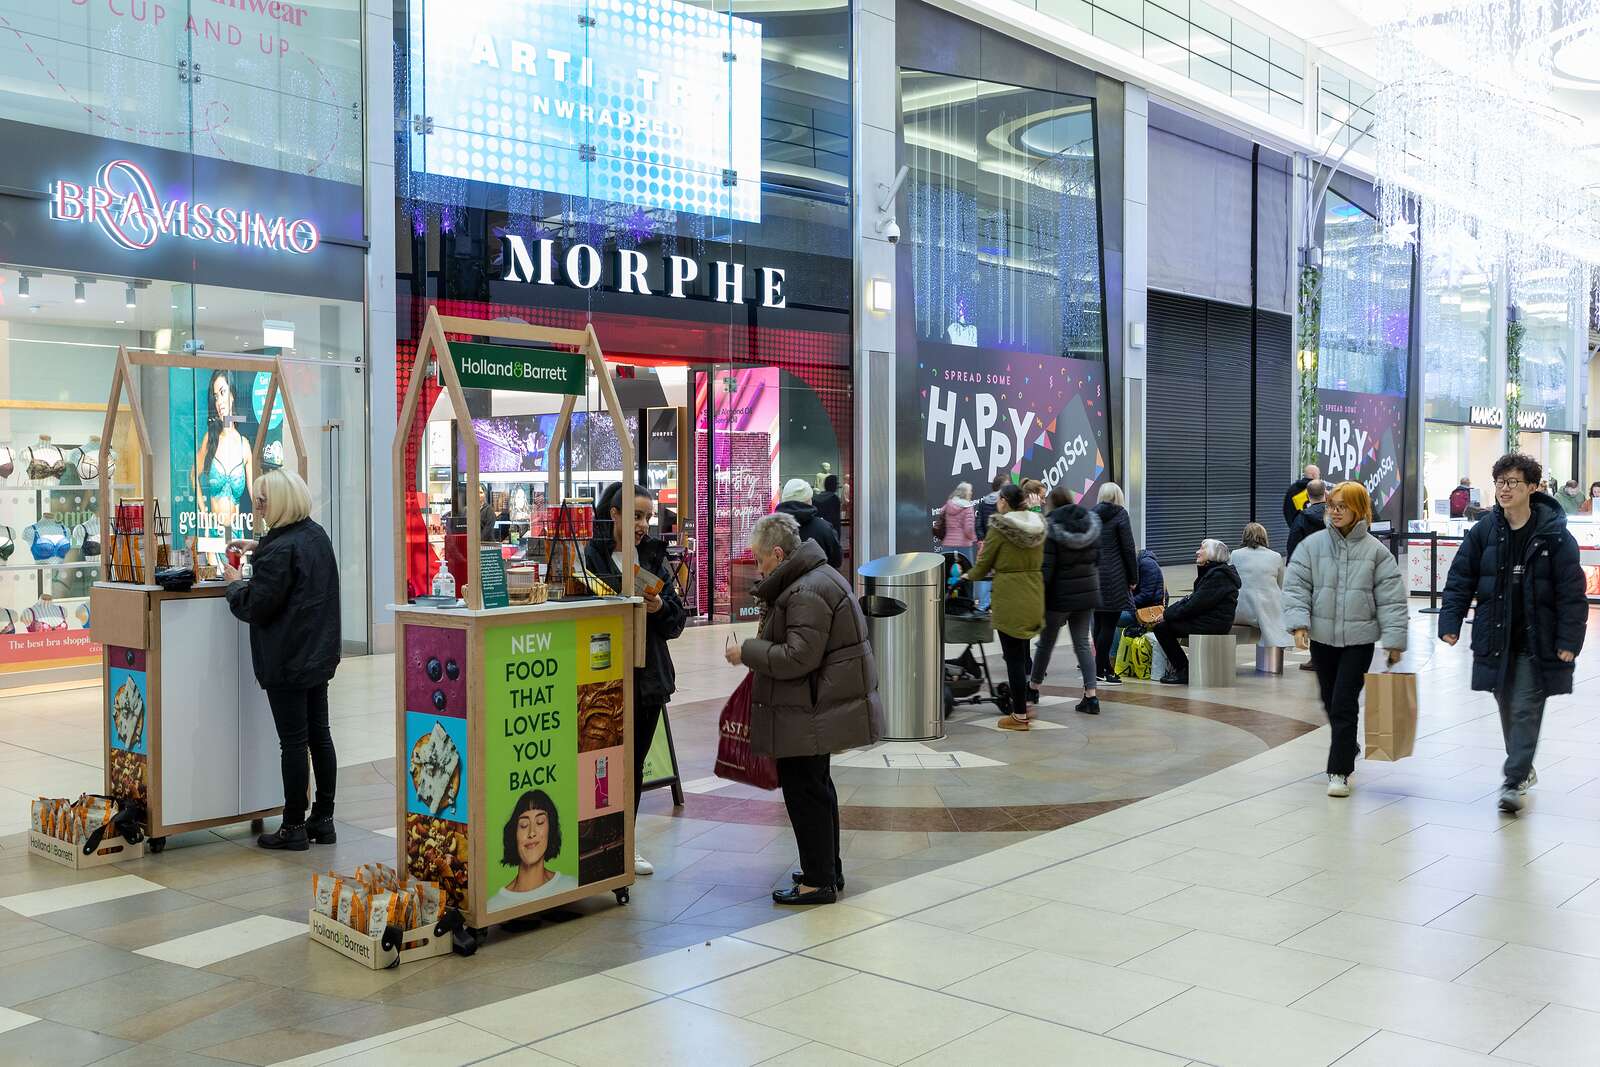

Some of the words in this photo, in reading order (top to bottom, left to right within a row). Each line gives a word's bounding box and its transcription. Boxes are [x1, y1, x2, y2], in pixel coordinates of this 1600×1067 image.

[210, 0, 308, 27] wear
[109, 0, 166, 25] CUP
[184, 15, 242, 46] AND
[259, 32, 290, 58] UP
[470, 31, 716, 110] ARTITR
[533, 95, 684, 137] NWRAPPED
[52, 159, 320, 251] BRAVISSIMO
[503, 234, 787, 309] MORPHE
[944, 370, 982, 383] SPREAD
[986, 372, 1011, 386] SOME
[926, 385, 1036, 484] HAPPY
[1040, 434, 1088, 498] donSq.
[739, 607, 760, 617] MOS
[8, 639, 25, 650] The
[27, 638, 44, 649] best
[46, 638, 61, 647] bra
[63, 635, 91, 647] shoppi
[511, 632, 552, 656] NEW
[506, 658, 558, 683] FOOD
[510, 684, 555, 709] THAT
[504, 710, 561, 738] LOVES
[513, 738, 552, 762] YOU
[509, 765, 557, 791] BACK
